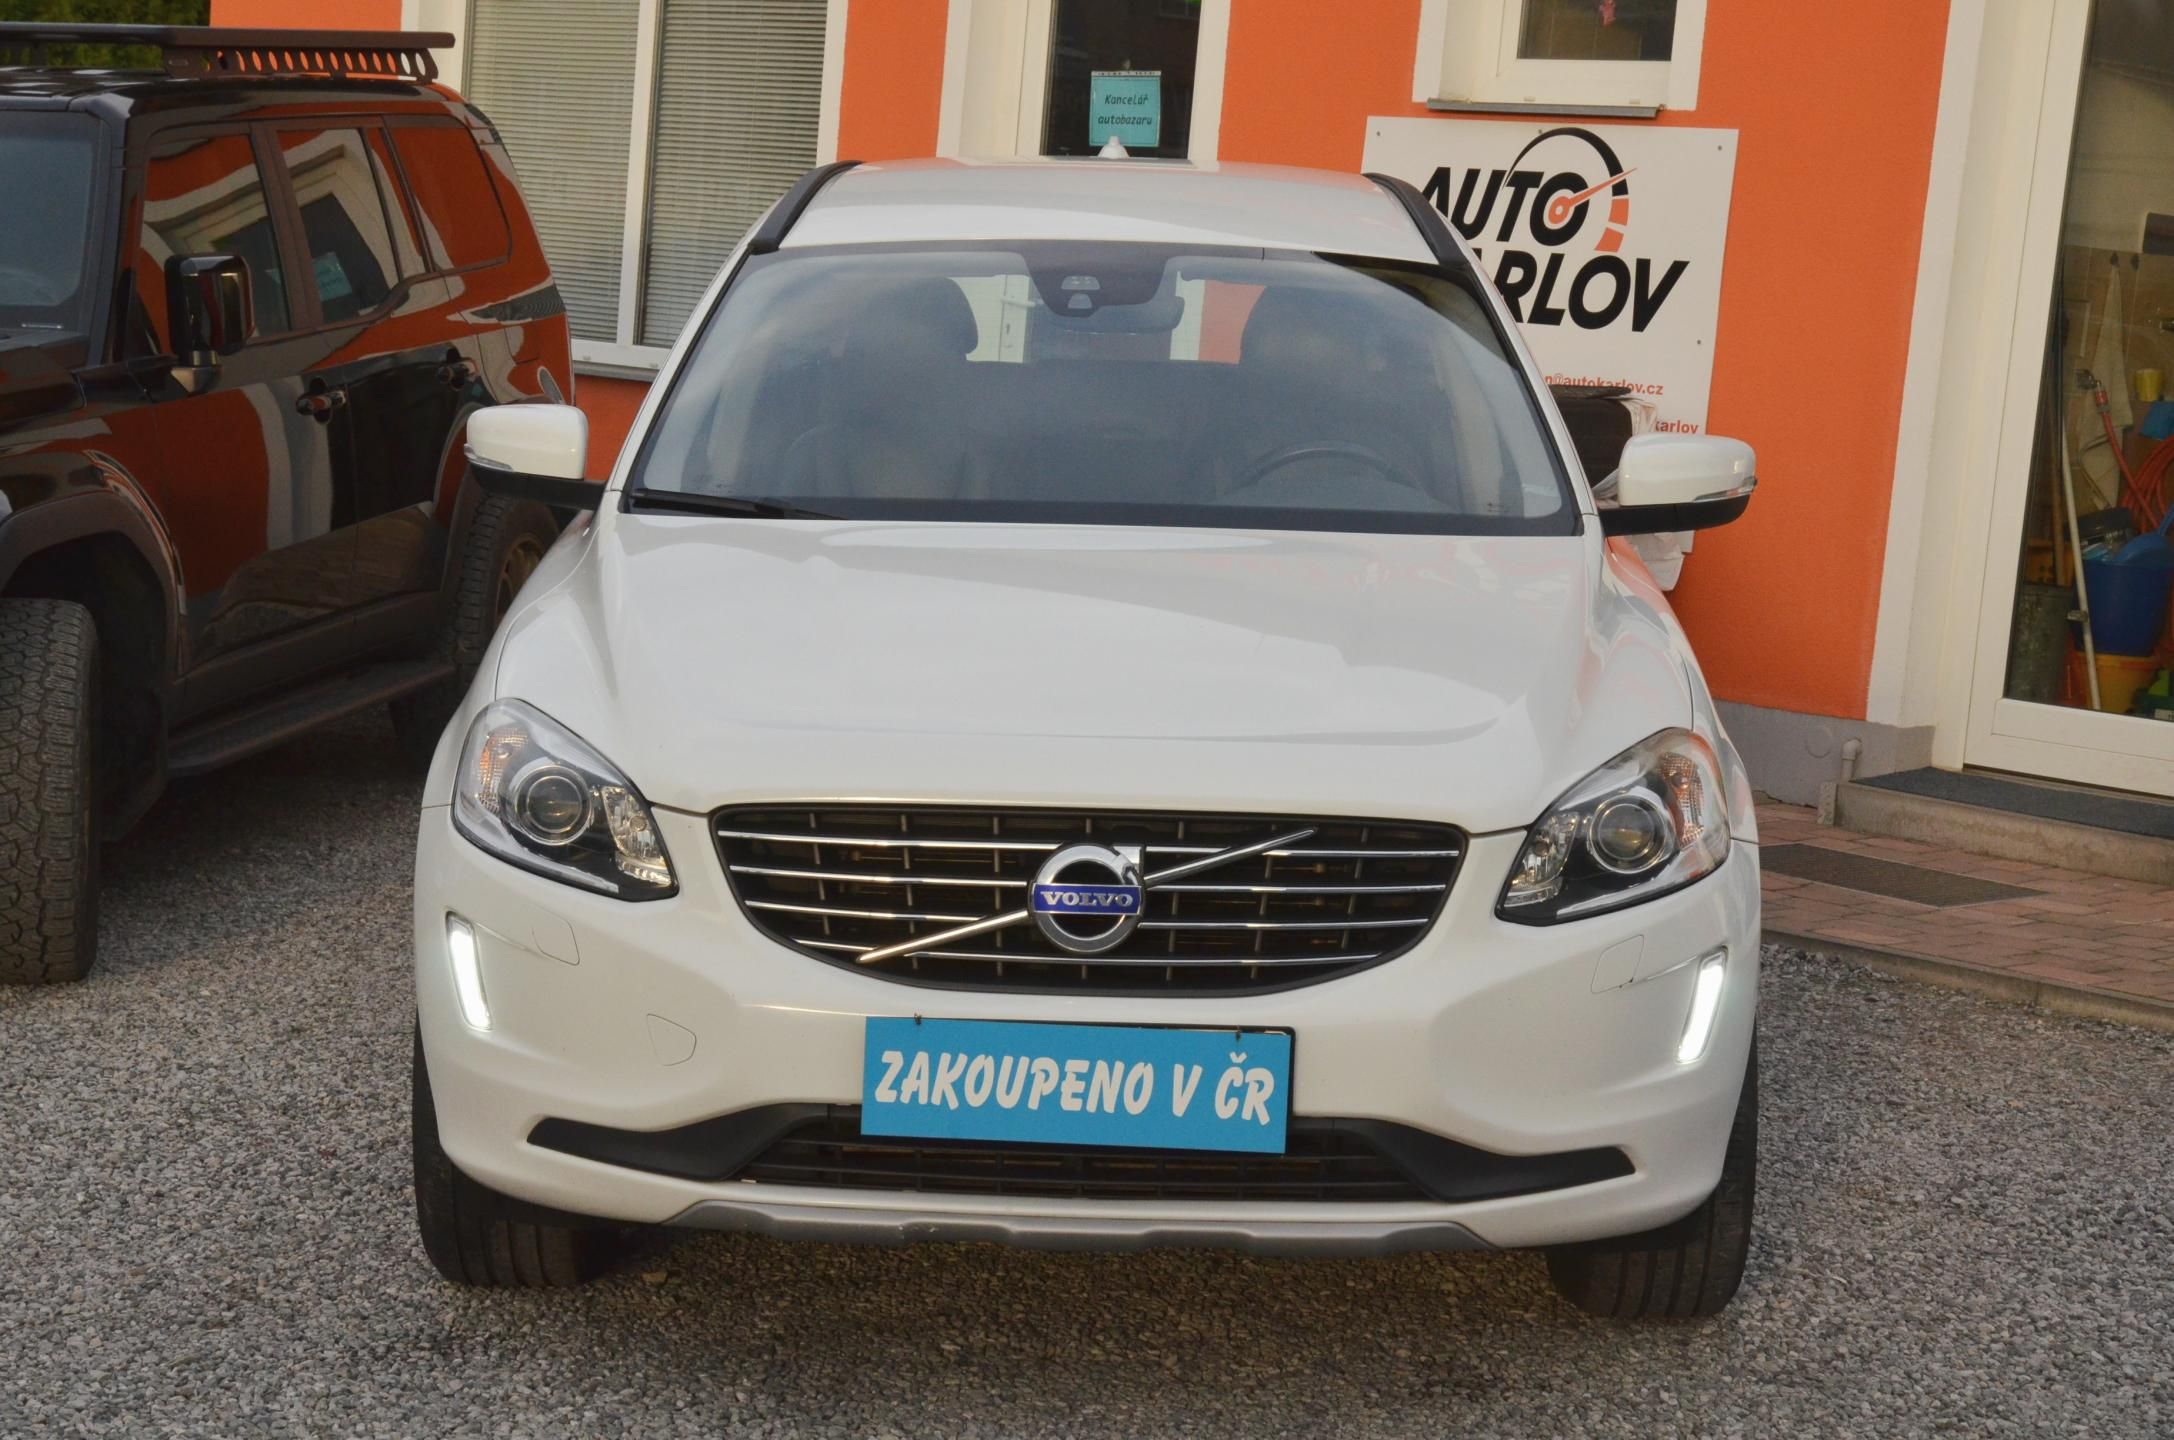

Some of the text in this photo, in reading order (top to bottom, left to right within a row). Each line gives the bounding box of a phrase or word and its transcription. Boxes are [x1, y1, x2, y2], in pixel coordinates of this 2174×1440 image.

[1097, 115, 1153, 126] autobazaru
[1421, 166, 1590, 247] AUTO
[1471, 247, 1690, 332] RLOV
[1040, 891, 1134, 907] VOLVO
[874, 1050, 1276, 1126] ZAKOUPENO V ČR
